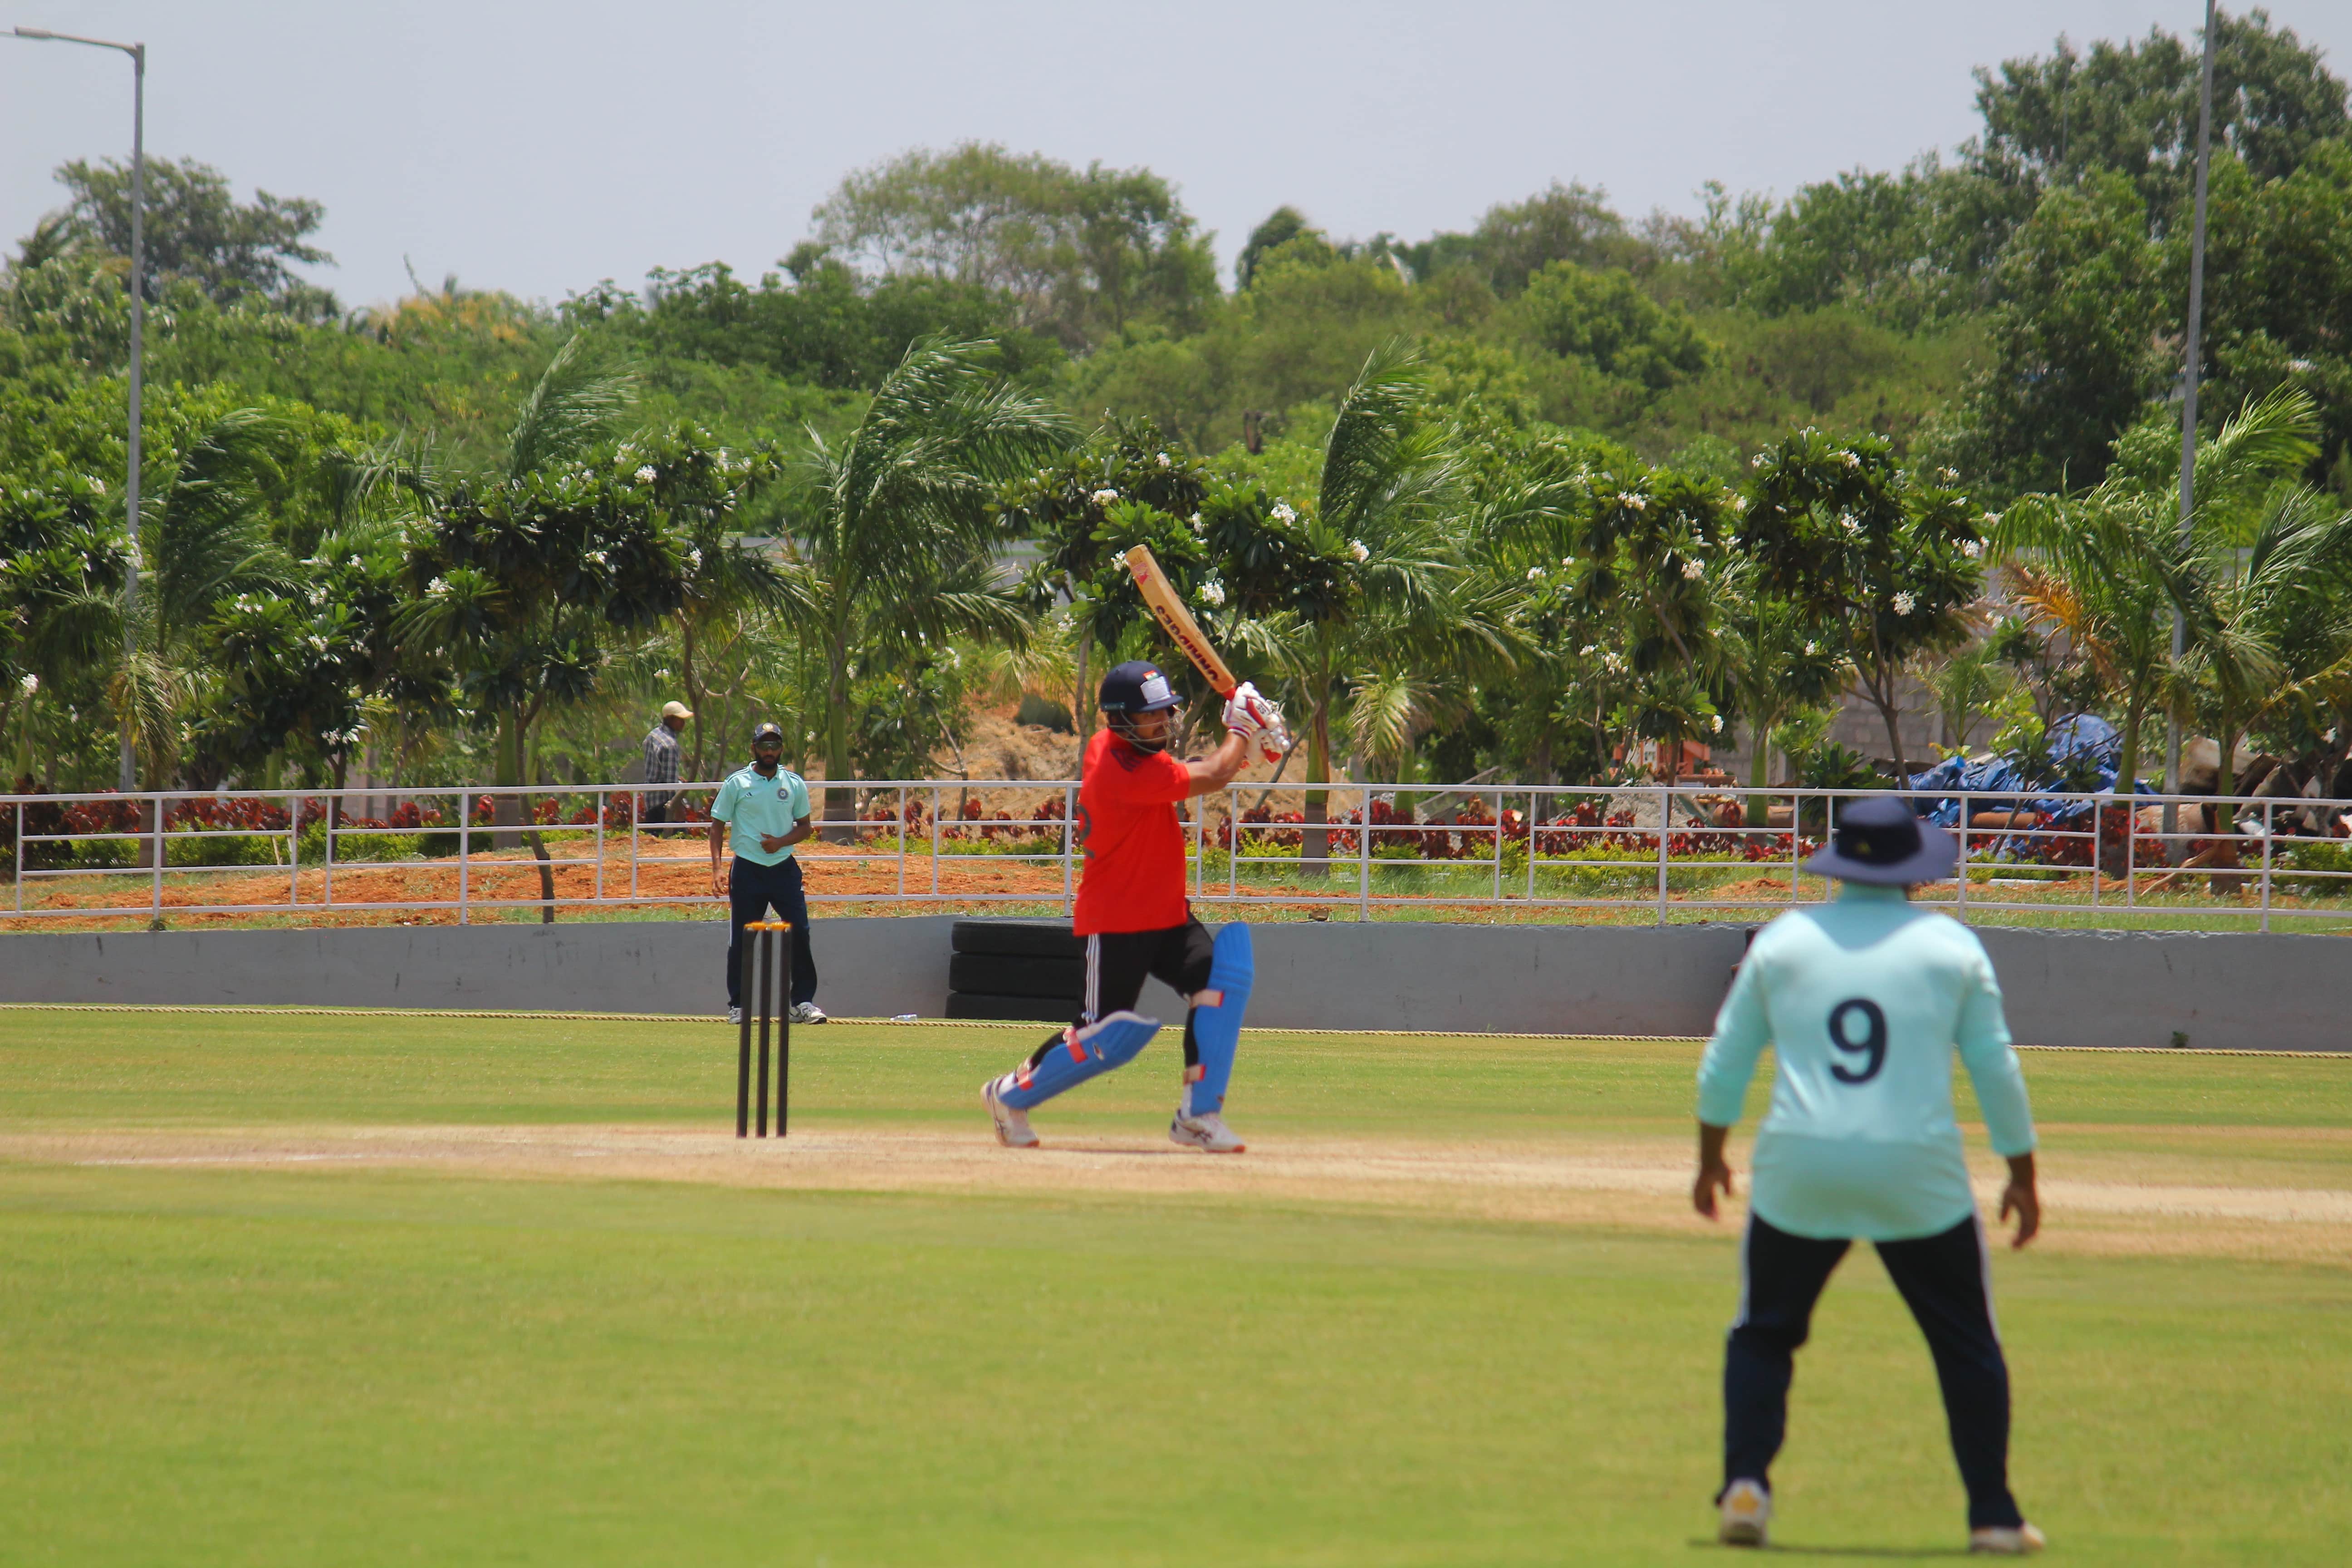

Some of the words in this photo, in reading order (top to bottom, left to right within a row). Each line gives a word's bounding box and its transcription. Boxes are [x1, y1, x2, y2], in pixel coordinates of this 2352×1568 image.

[1155, 605, 1220, 681] UNRIDGES
[1256, 704, 1267, 715] SS
[1828, 997, 1888, 1085] 9
